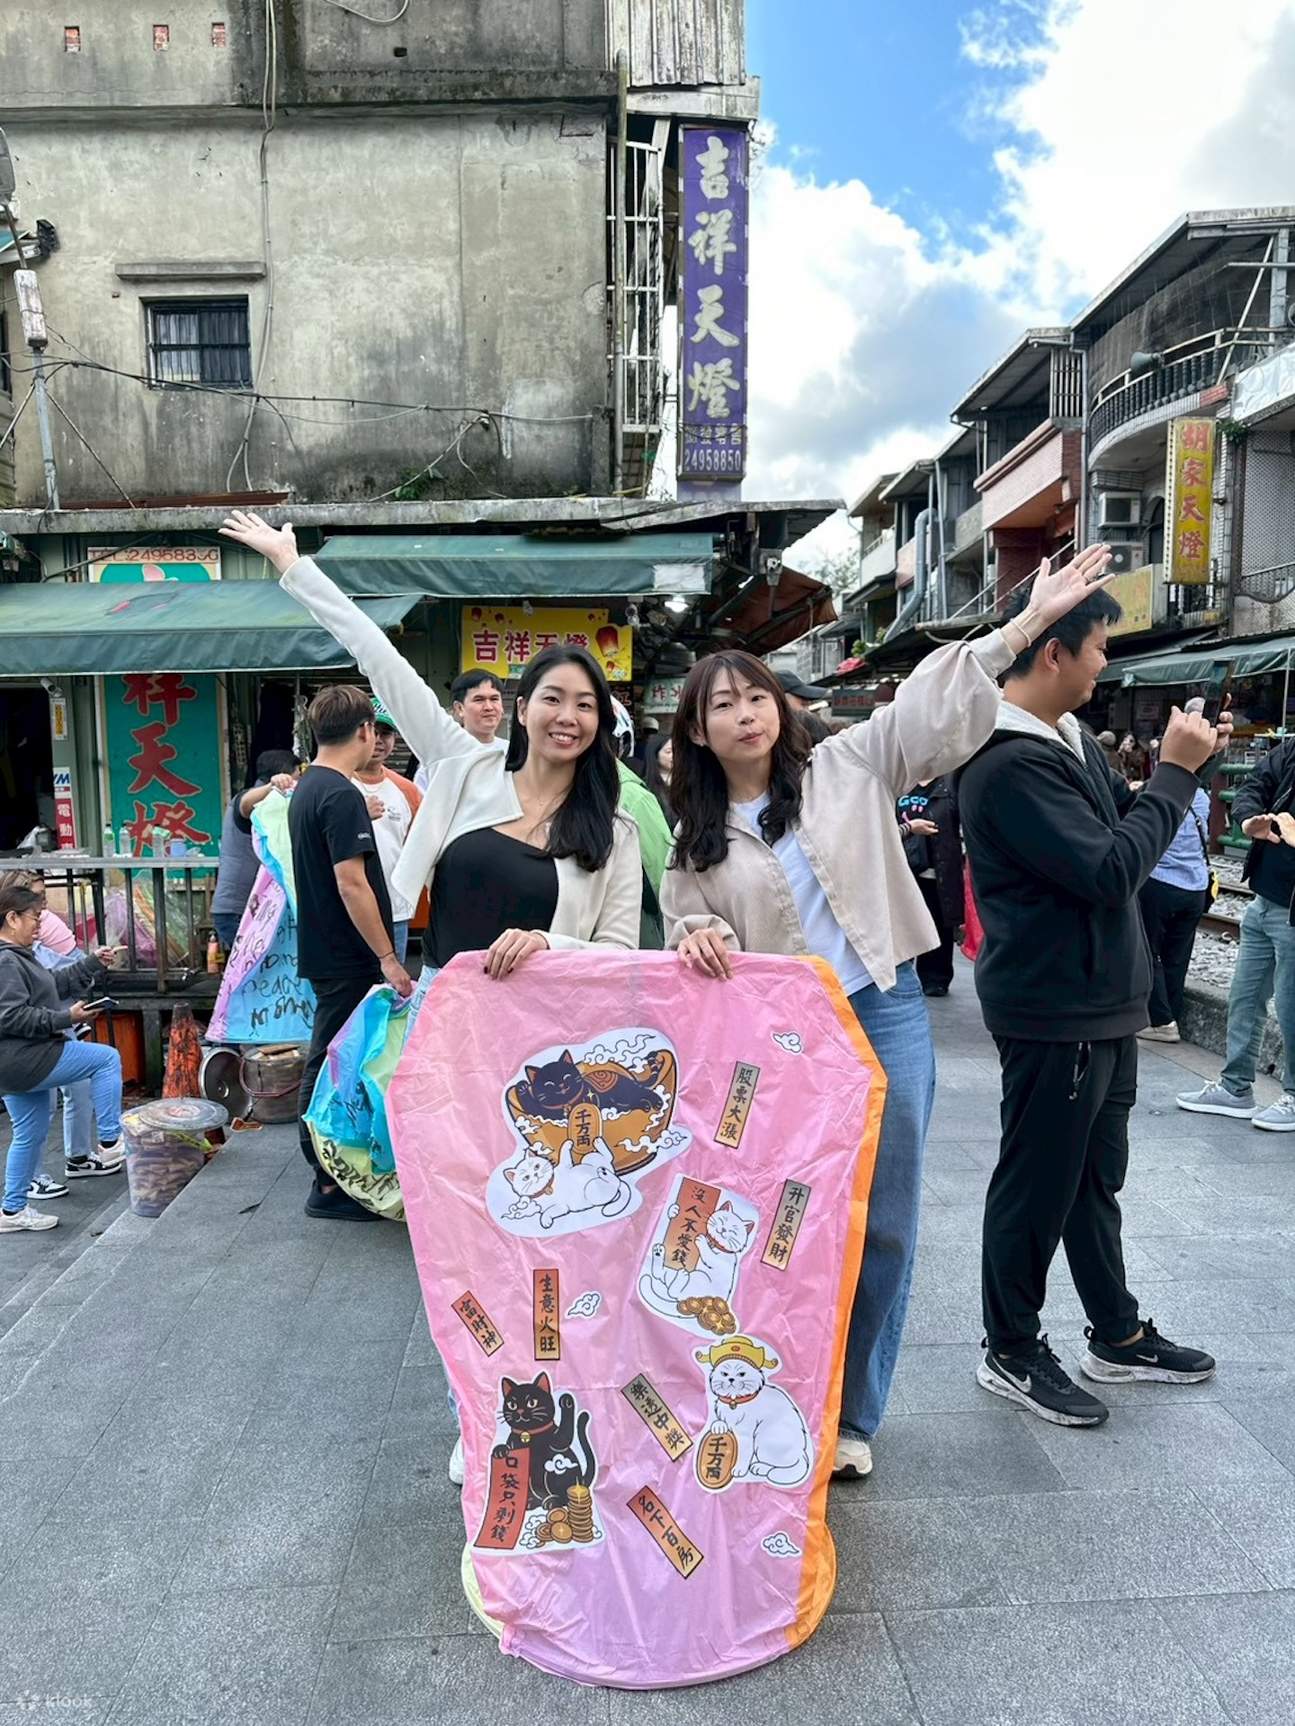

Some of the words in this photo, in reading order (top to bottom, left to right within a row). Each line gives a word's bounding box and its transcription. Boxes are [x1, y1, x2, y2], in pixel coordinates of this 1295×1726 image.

[687, 135, 741, 419] 吉祥天燈
[684, 448, 742, 472] 24958850
[57, 802, 75, 849] 電動
[719, 1066, 754, 1141] 股票大漲
[768, 1186, 805, 1263] 升官發財
[538, 1272, 557, 1353] 生意火旺
